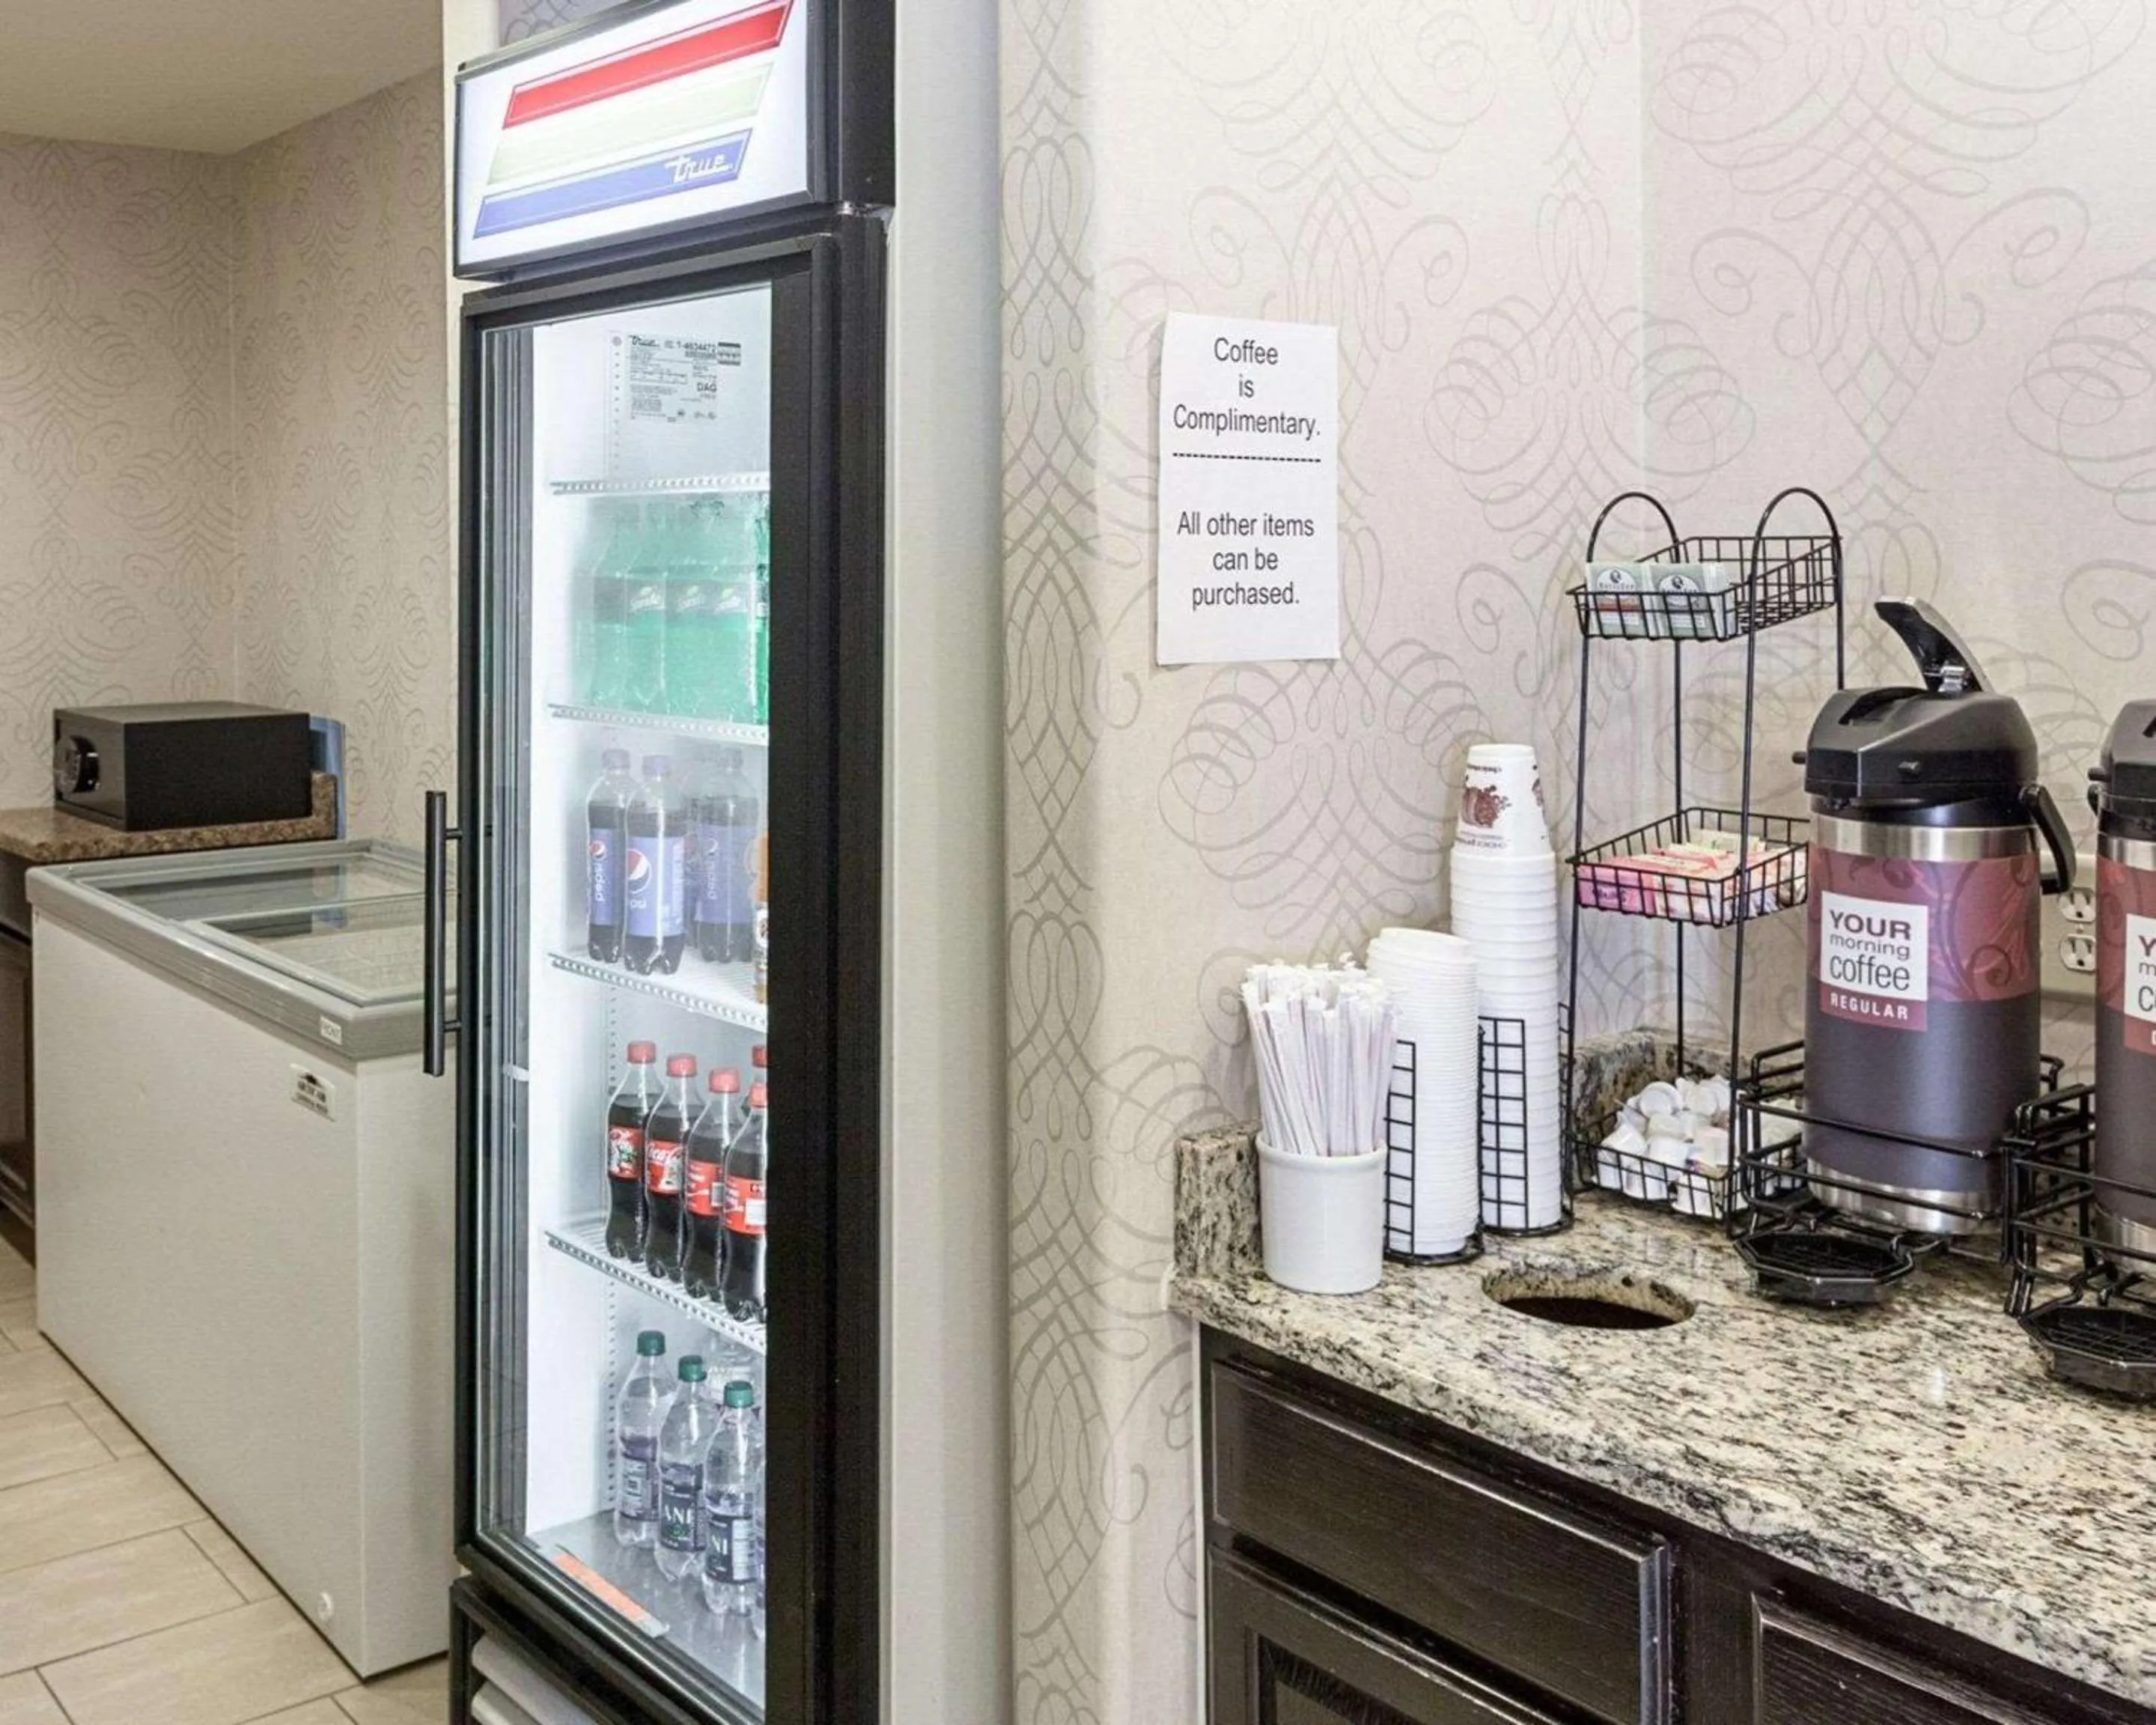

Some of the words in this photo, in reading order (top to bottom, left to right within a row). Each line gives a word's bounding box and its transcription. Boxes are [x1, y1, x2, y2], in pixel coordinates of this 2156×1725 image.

[1213, 337, 1279, 365] Coffee
[1238, 374, 1255, 398] is
[1173, 404, 1321, 441] Complimentary.
[1177, 511, 1201, 535] All
[1207, 512, 1257, 536] other
[1263, 512, 1315, 537] items
[1213, 552, 1249, 571] can
[1255, 547, 1279, 571] be
[1192, 581, 1300, 612] purchased.
[1830, 910, 1911, 940] YOUR
[1830, 933, 1910, 961] morning
[1830, 953, 1910, 991] coffee
[1830, 992, 1909, 1020] REGULAR
